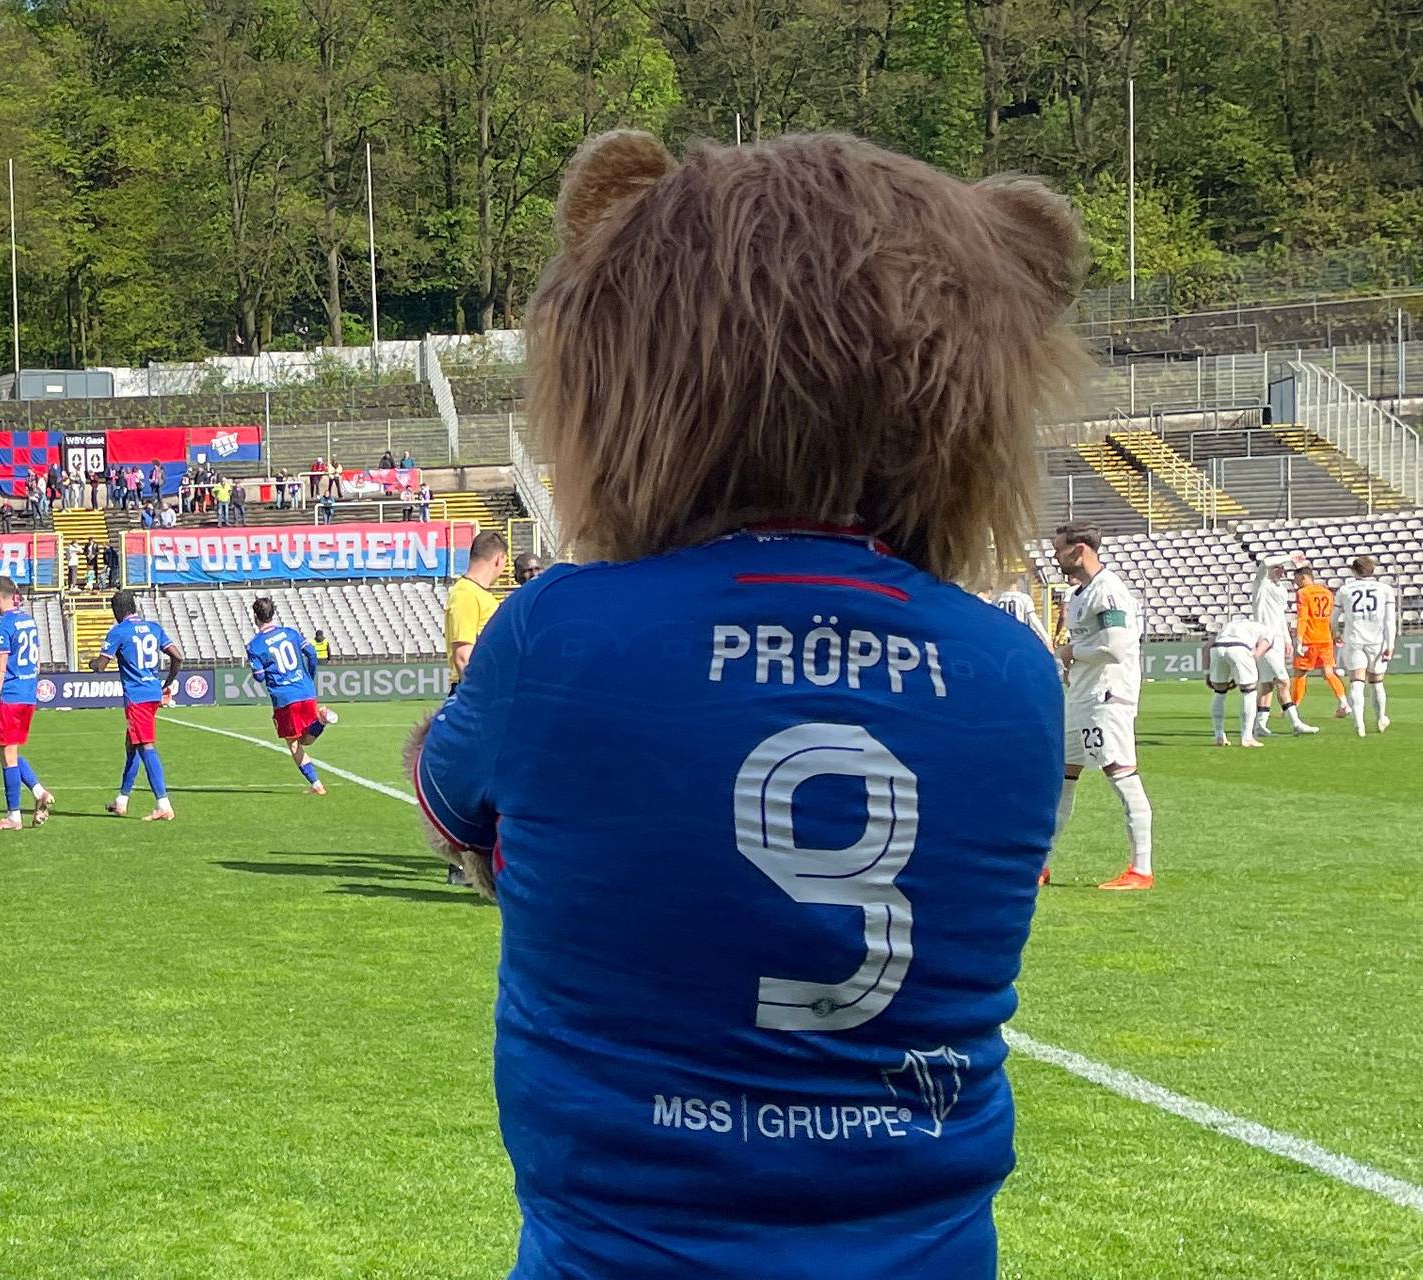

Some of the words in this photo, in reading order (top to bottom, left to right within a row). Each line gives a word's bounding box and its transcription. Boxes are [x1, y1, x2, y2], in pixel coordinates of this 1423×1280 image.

[1314, 596, 1330, 617] 32
[1352, 589, 1377, 612] 25
[17, 629, 38, 666] 26
[132, 633, 158, 670] 19
[268, 640, 297, 674] 10
[709, 615, 946, 697] PRÖPPI
[63, 679, 124, 698] STADION
[318, 667, 449, 696] RGISCH
[1082, 726, 1105, 749] 23
[733, 722, 919, 1032] 9
[653, 1094, 733, 1133] MSS
